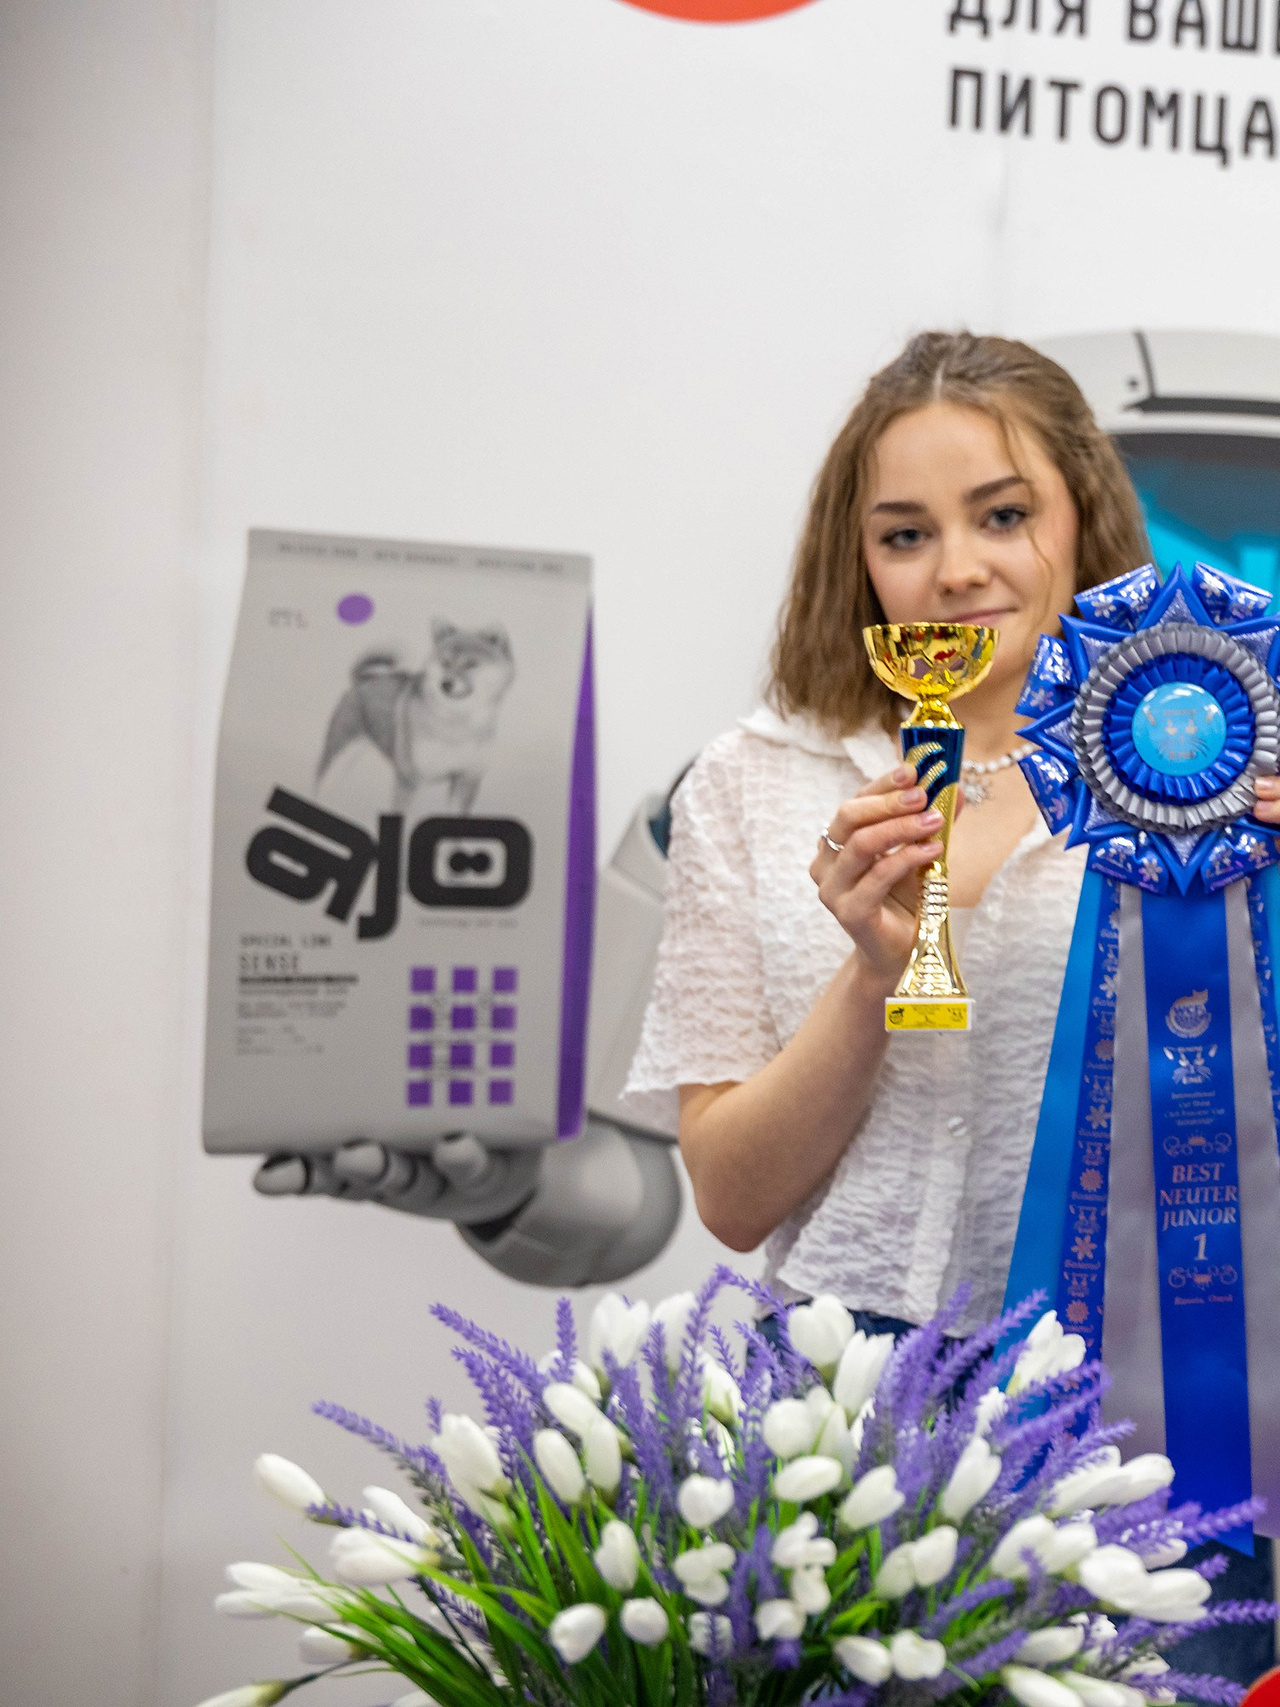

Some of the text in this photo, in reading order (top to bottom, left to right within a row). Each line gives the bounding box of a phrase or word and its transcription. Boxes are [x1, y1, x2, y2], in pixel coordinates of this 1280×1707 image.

[948, 68, 1279, 170] ПИТОМЦА
[1172, 1162, 1225, 1184] BEST
[1160, 1185, 1238, 1206] NEUTER
[1162, 1207, 1236, 1231] JUNIOR
[1193, 1233, 1208, 1261] 1
